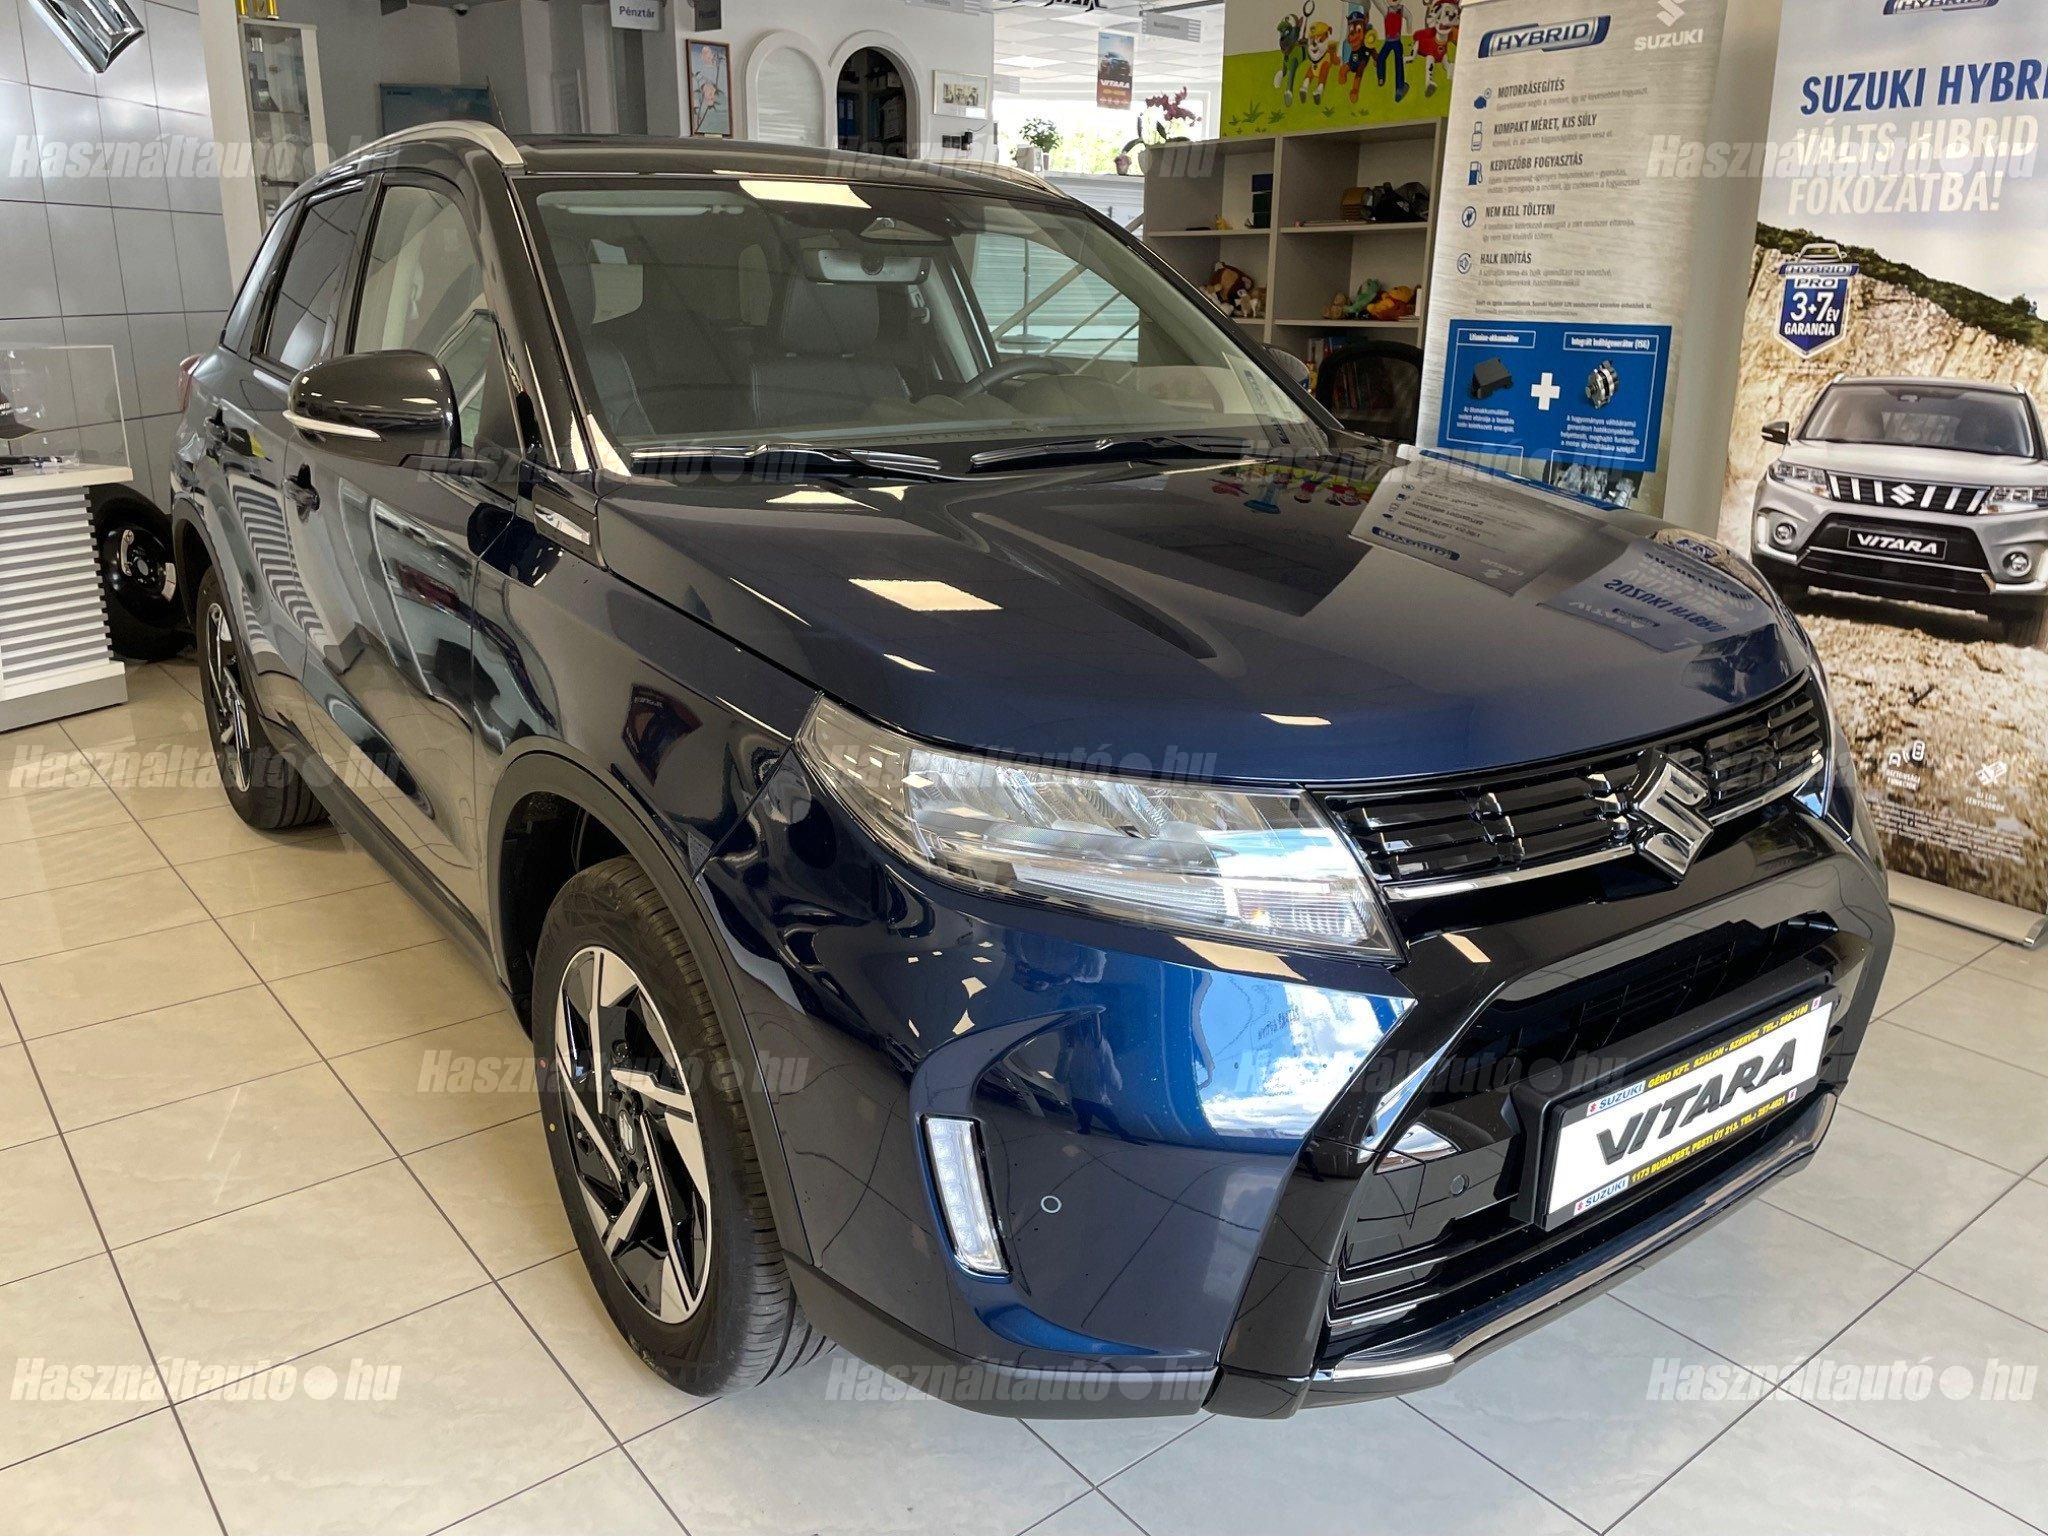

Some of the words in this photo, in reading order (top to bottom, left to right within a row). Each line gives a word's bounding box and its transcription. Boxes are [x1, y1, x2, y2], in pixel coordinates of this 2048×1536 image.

[619, 6, 655, 18] Pénztár
[1496, 21, 1590, 52] HYBRID
[1634, 28, 1703, 52] SUZUKI
[1800, 68, 1926, 115] SUZUKI
[1937, 59, 2048, 106] HYBR
[1493, 120, 1528, 135] KOMPAKT
[1530, 117, 1560, 132] MÉRET,
[1561, 116, 1576, 129] KIS
[1577, 113, 1598, 127] SÚLY
[1796, 118, 1897, 166] VÁLTS
[1907, 115, 2039, 161] HIBRID
[1533, 153, 1584, 169] FOGYASZTÁS
[1788, 170, 2004, 216] FOKOZATBA!
[1485, 205, 1501, 218] NEM
[1502, 204, 1520, 217] KELL
[1480, 252, 1499, 265] HALK
[1500, 250, 1532, 265] INDÍTÁS
[1790, 265, 1847, 275] HYBRID
[1796, 278, 1836, 287] PRO
[1784, 322, 1836, 336] GARANCIA
[1856, 533, 1938, 556] VITARA
[1599, 1084, 1644, 1110] SUZUKI
[1672, 1062, 1690, 1079] KFT.
[1693, 1047, 1724, 1068] SZALON
[1728, 1029, 1760, 1052] SZERVIZ
[1596, 1038, 1797, 1166] VITARA
[1584, 1181, 1627, 1207] SUZUKI
[1650, 1147, 1690, 1174] BUDAPEST,
[1691, 1136, 1713, 1155] PESTI
